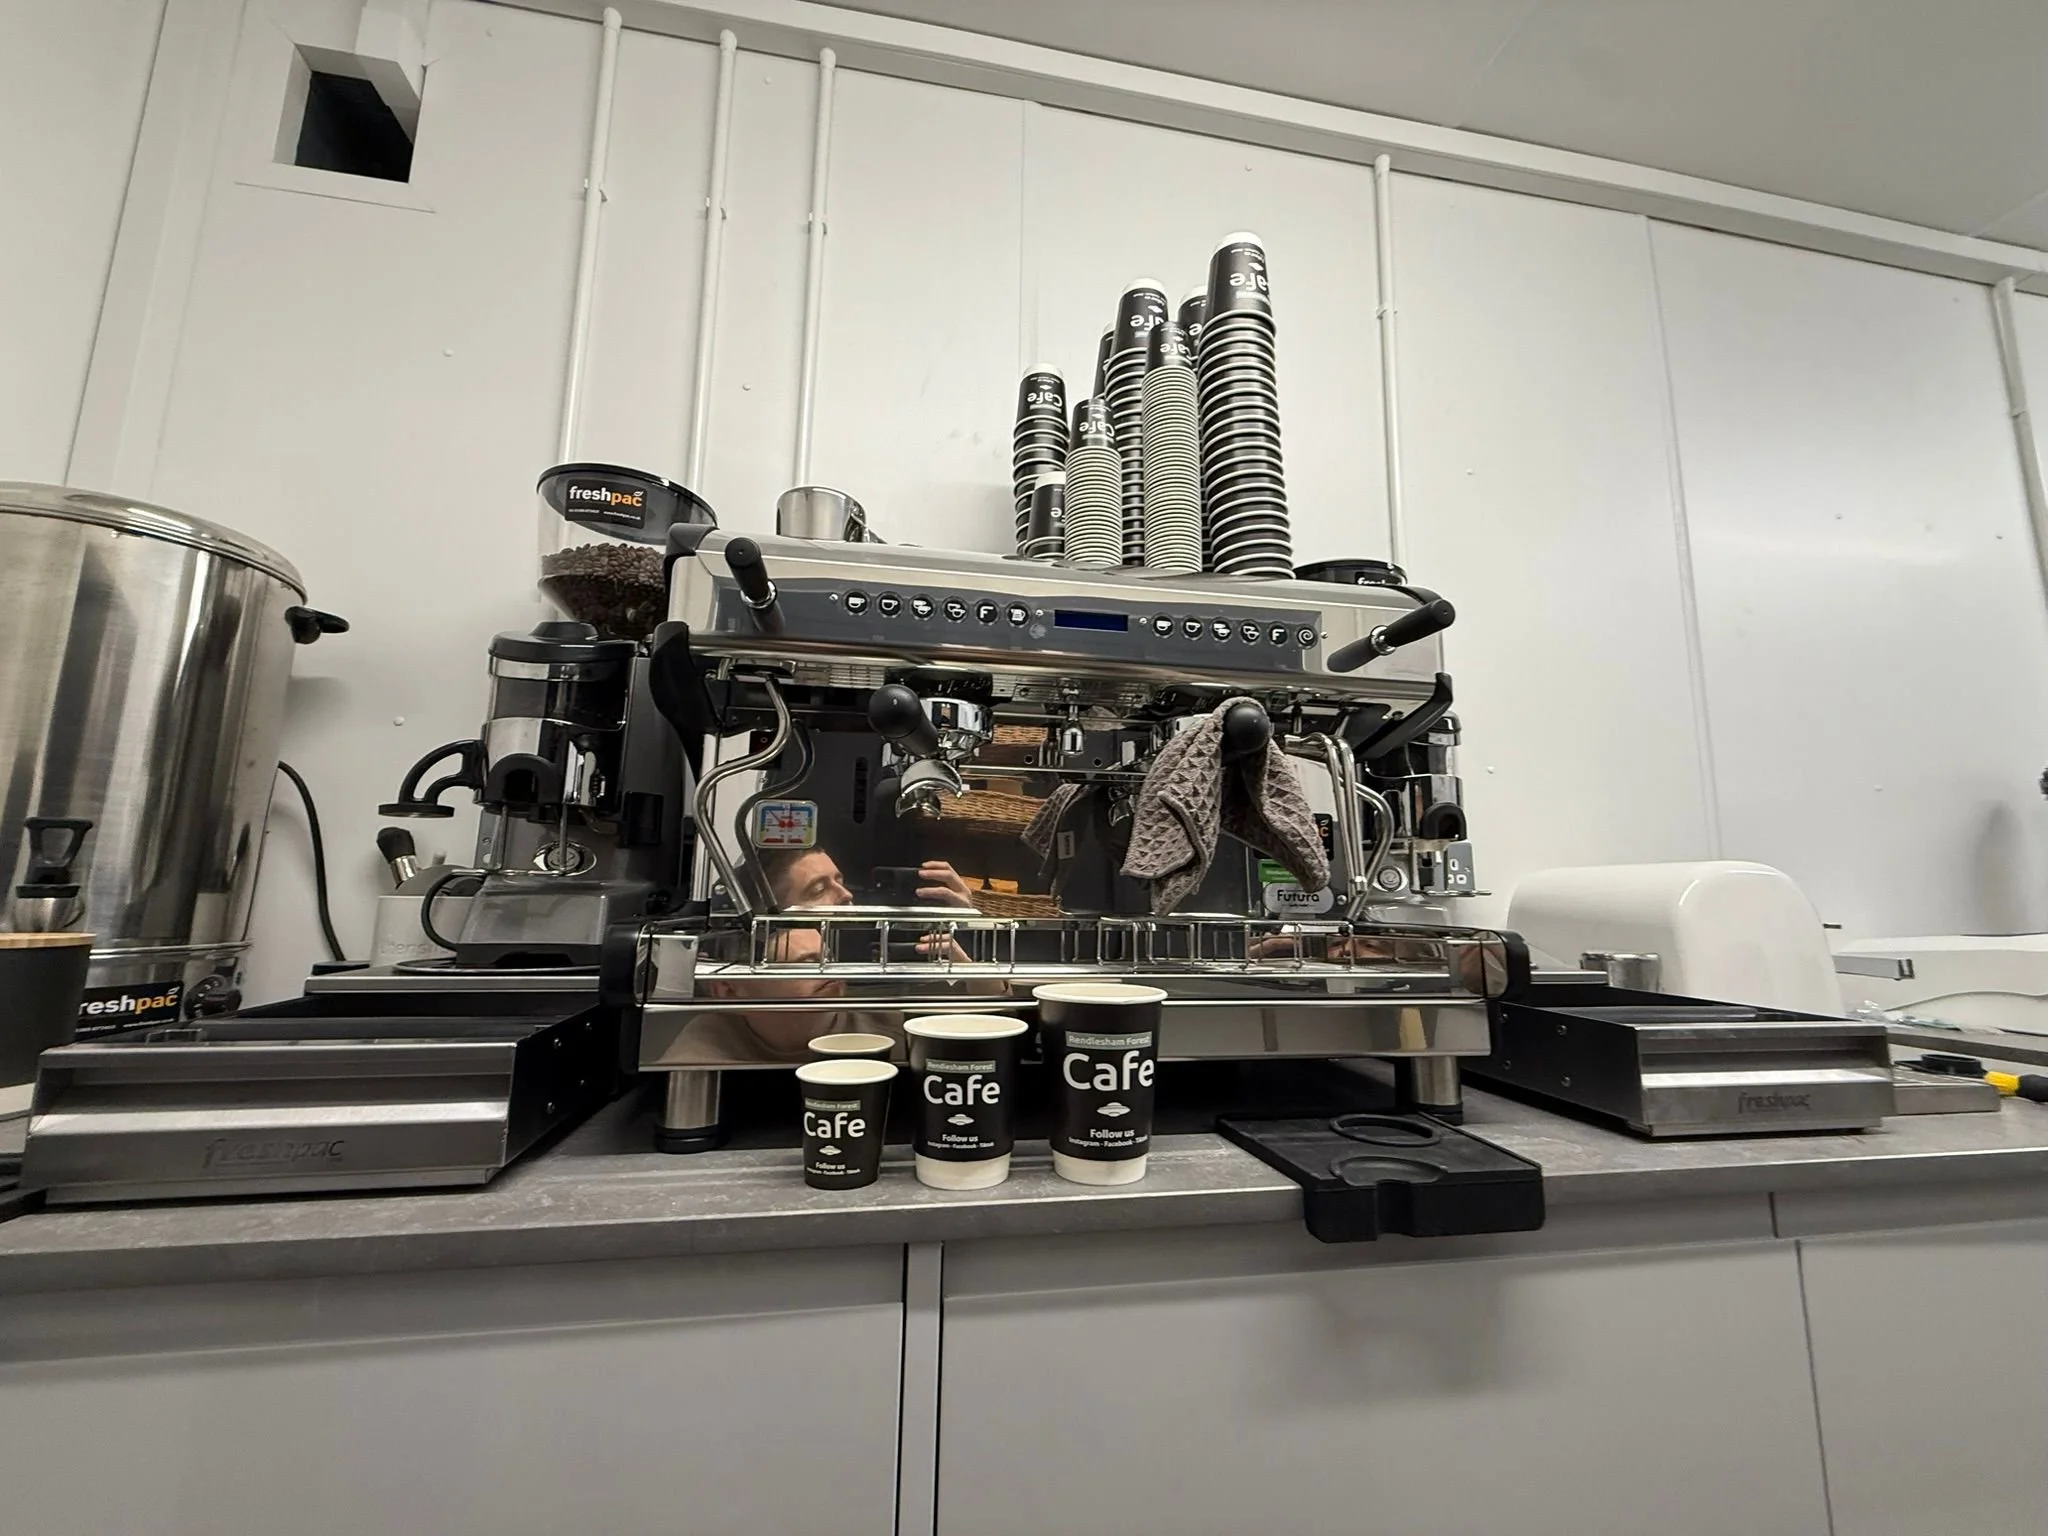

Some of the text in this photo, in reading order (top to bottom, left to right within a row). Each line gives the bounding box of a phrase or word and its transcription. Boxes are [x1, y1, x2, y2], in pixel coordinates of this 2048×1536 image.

[1229, 272, 1268, 291] afe
[1027, 391, 1063, 407] Cafe
[1079, 420, 1115, 437] Cafe
[569, 486, 642, 507] freshpac
[1277, 889, 1320, 902] Futura
[79, 994, 178, 1015] reshpac
[1069, 1035, 1150, 1046] Rendlesham Forest
[1063, 1050, 1155, 1091] Cafe
[923, 1074, 1000, 1105] Cafe
[804, 1111, 866, 1138] Cafe
[942, 1133, 968, 1142] Follow
[1090, 1129, 1135, 1139] Follow us
